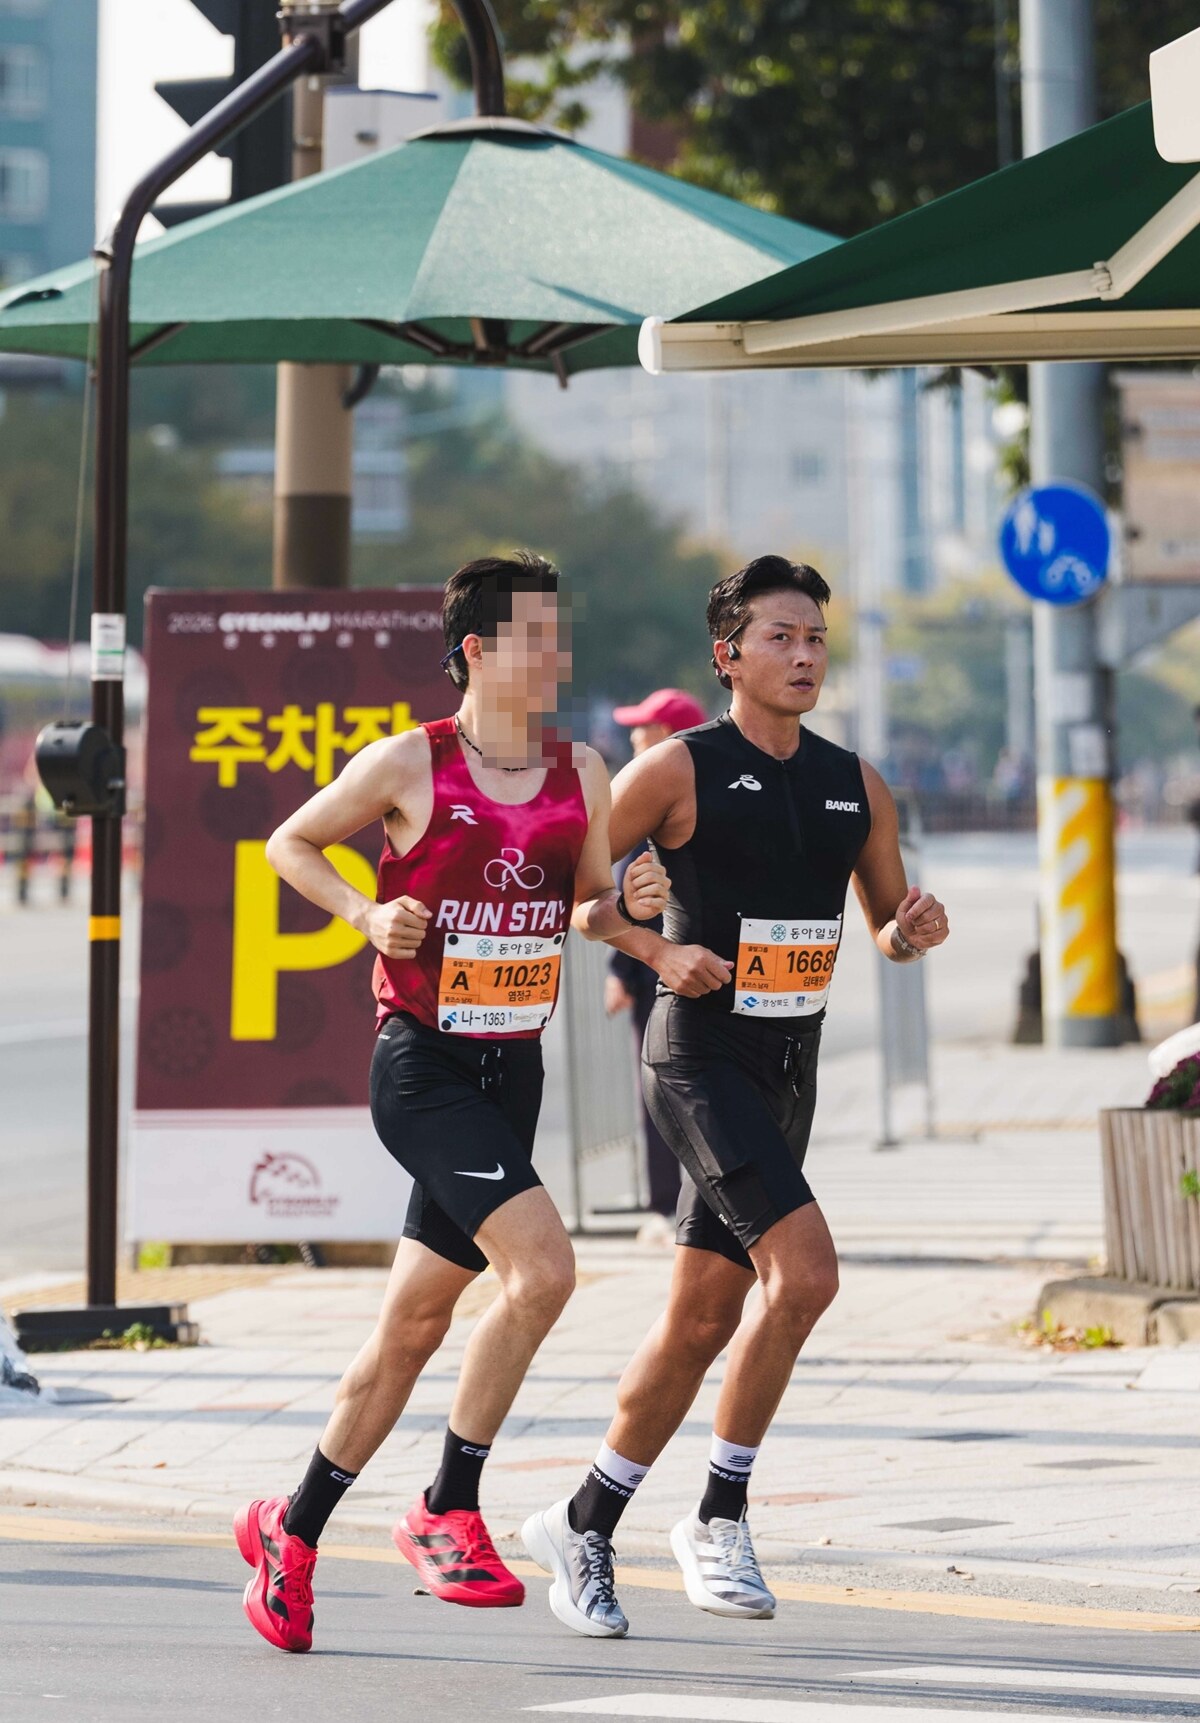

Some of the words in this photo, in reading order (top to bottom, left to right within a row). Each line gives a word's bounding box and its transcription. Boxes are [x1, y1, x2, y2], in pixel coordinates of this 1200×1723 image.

[219, 612, 331, 632] GYEONGJU
[435, 899, 504, 933] RUN
[230, 839, 377, 1041] P
[790, 928, 838, 940] 동아일보
[498, 943, 544, 955] 동아일보
[747, 955, 765, 976] A
[786, 949, 834, 974] 1668
[450, 970, 469, 991] A
[493, 962, 552, 988] 11023
